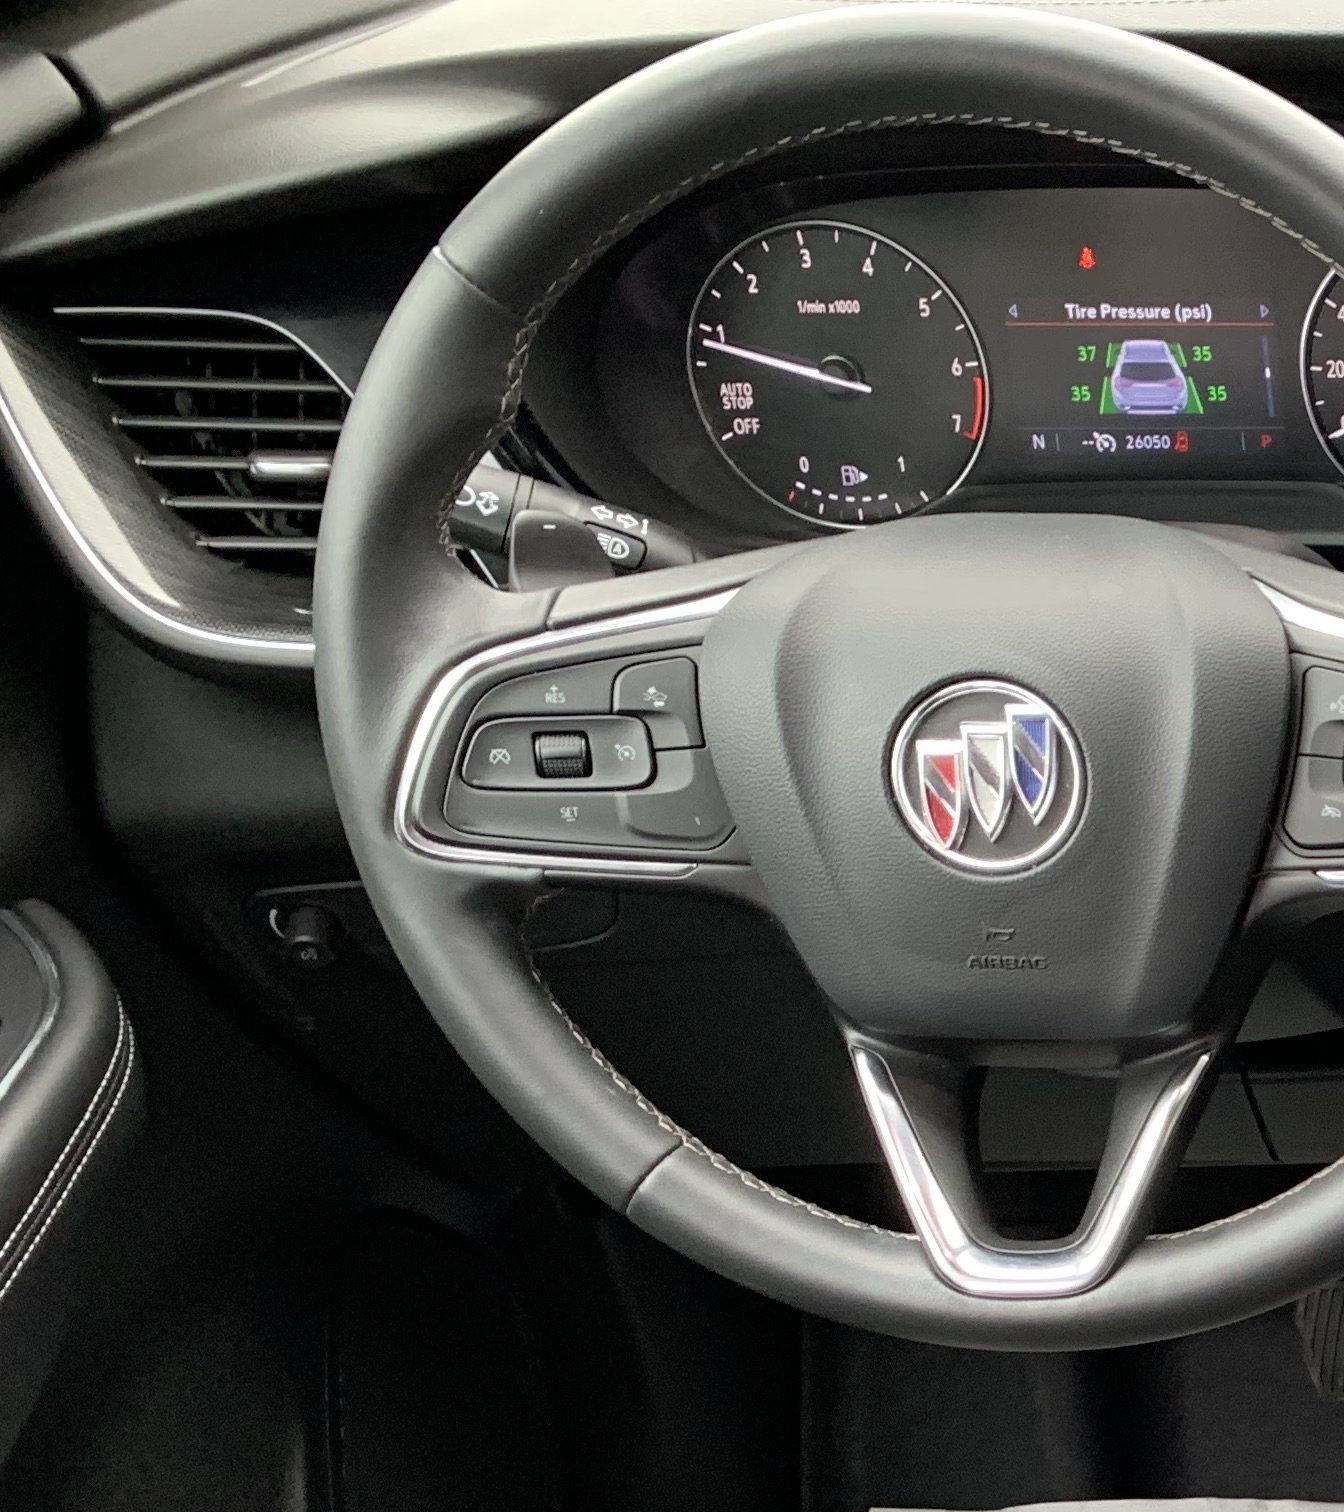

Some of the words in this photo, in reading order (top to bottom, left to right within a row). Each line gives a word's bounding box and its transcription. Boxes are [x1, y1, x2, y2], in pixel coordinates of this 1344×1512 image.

[800, 249, 812, 268] 3
[862, 258, 874, 276] 4
[746, 275, 758, 293] 2
[828, 300, 860, 314] x1000
[919, 298, 930, 317] 5
[1064, 304, 1096, 319] Tire
[1100, 304, 1171, 319] Pressure
[1174, 303, 1212, 322] (psi)
[716, 324, 725, 343] 1
[1077, 346, 1096, 361] 37
[1192, 346, 1211, 361] 35
[951, 357, 962, 376] 6
[720, 383, 752, 396] AUTO
[1071, 385, 1090, 401] 35
[1207, 385, 1227, 401] 35
[722, 396, 753, 410] STOP
[733, 417, 760, 434] OFF
[952, 415, 961, 433] 7
[1032, 434, 1045, 449] N
[1125, 434, 1171, 449] 26050
[1260, 434, 1272, 448] P
[799, 456, 809, 473] 0
[898, 456, 906, 472] 1
[545, 692, 566, 704] RES
[560, 806, 579, 818] SET
